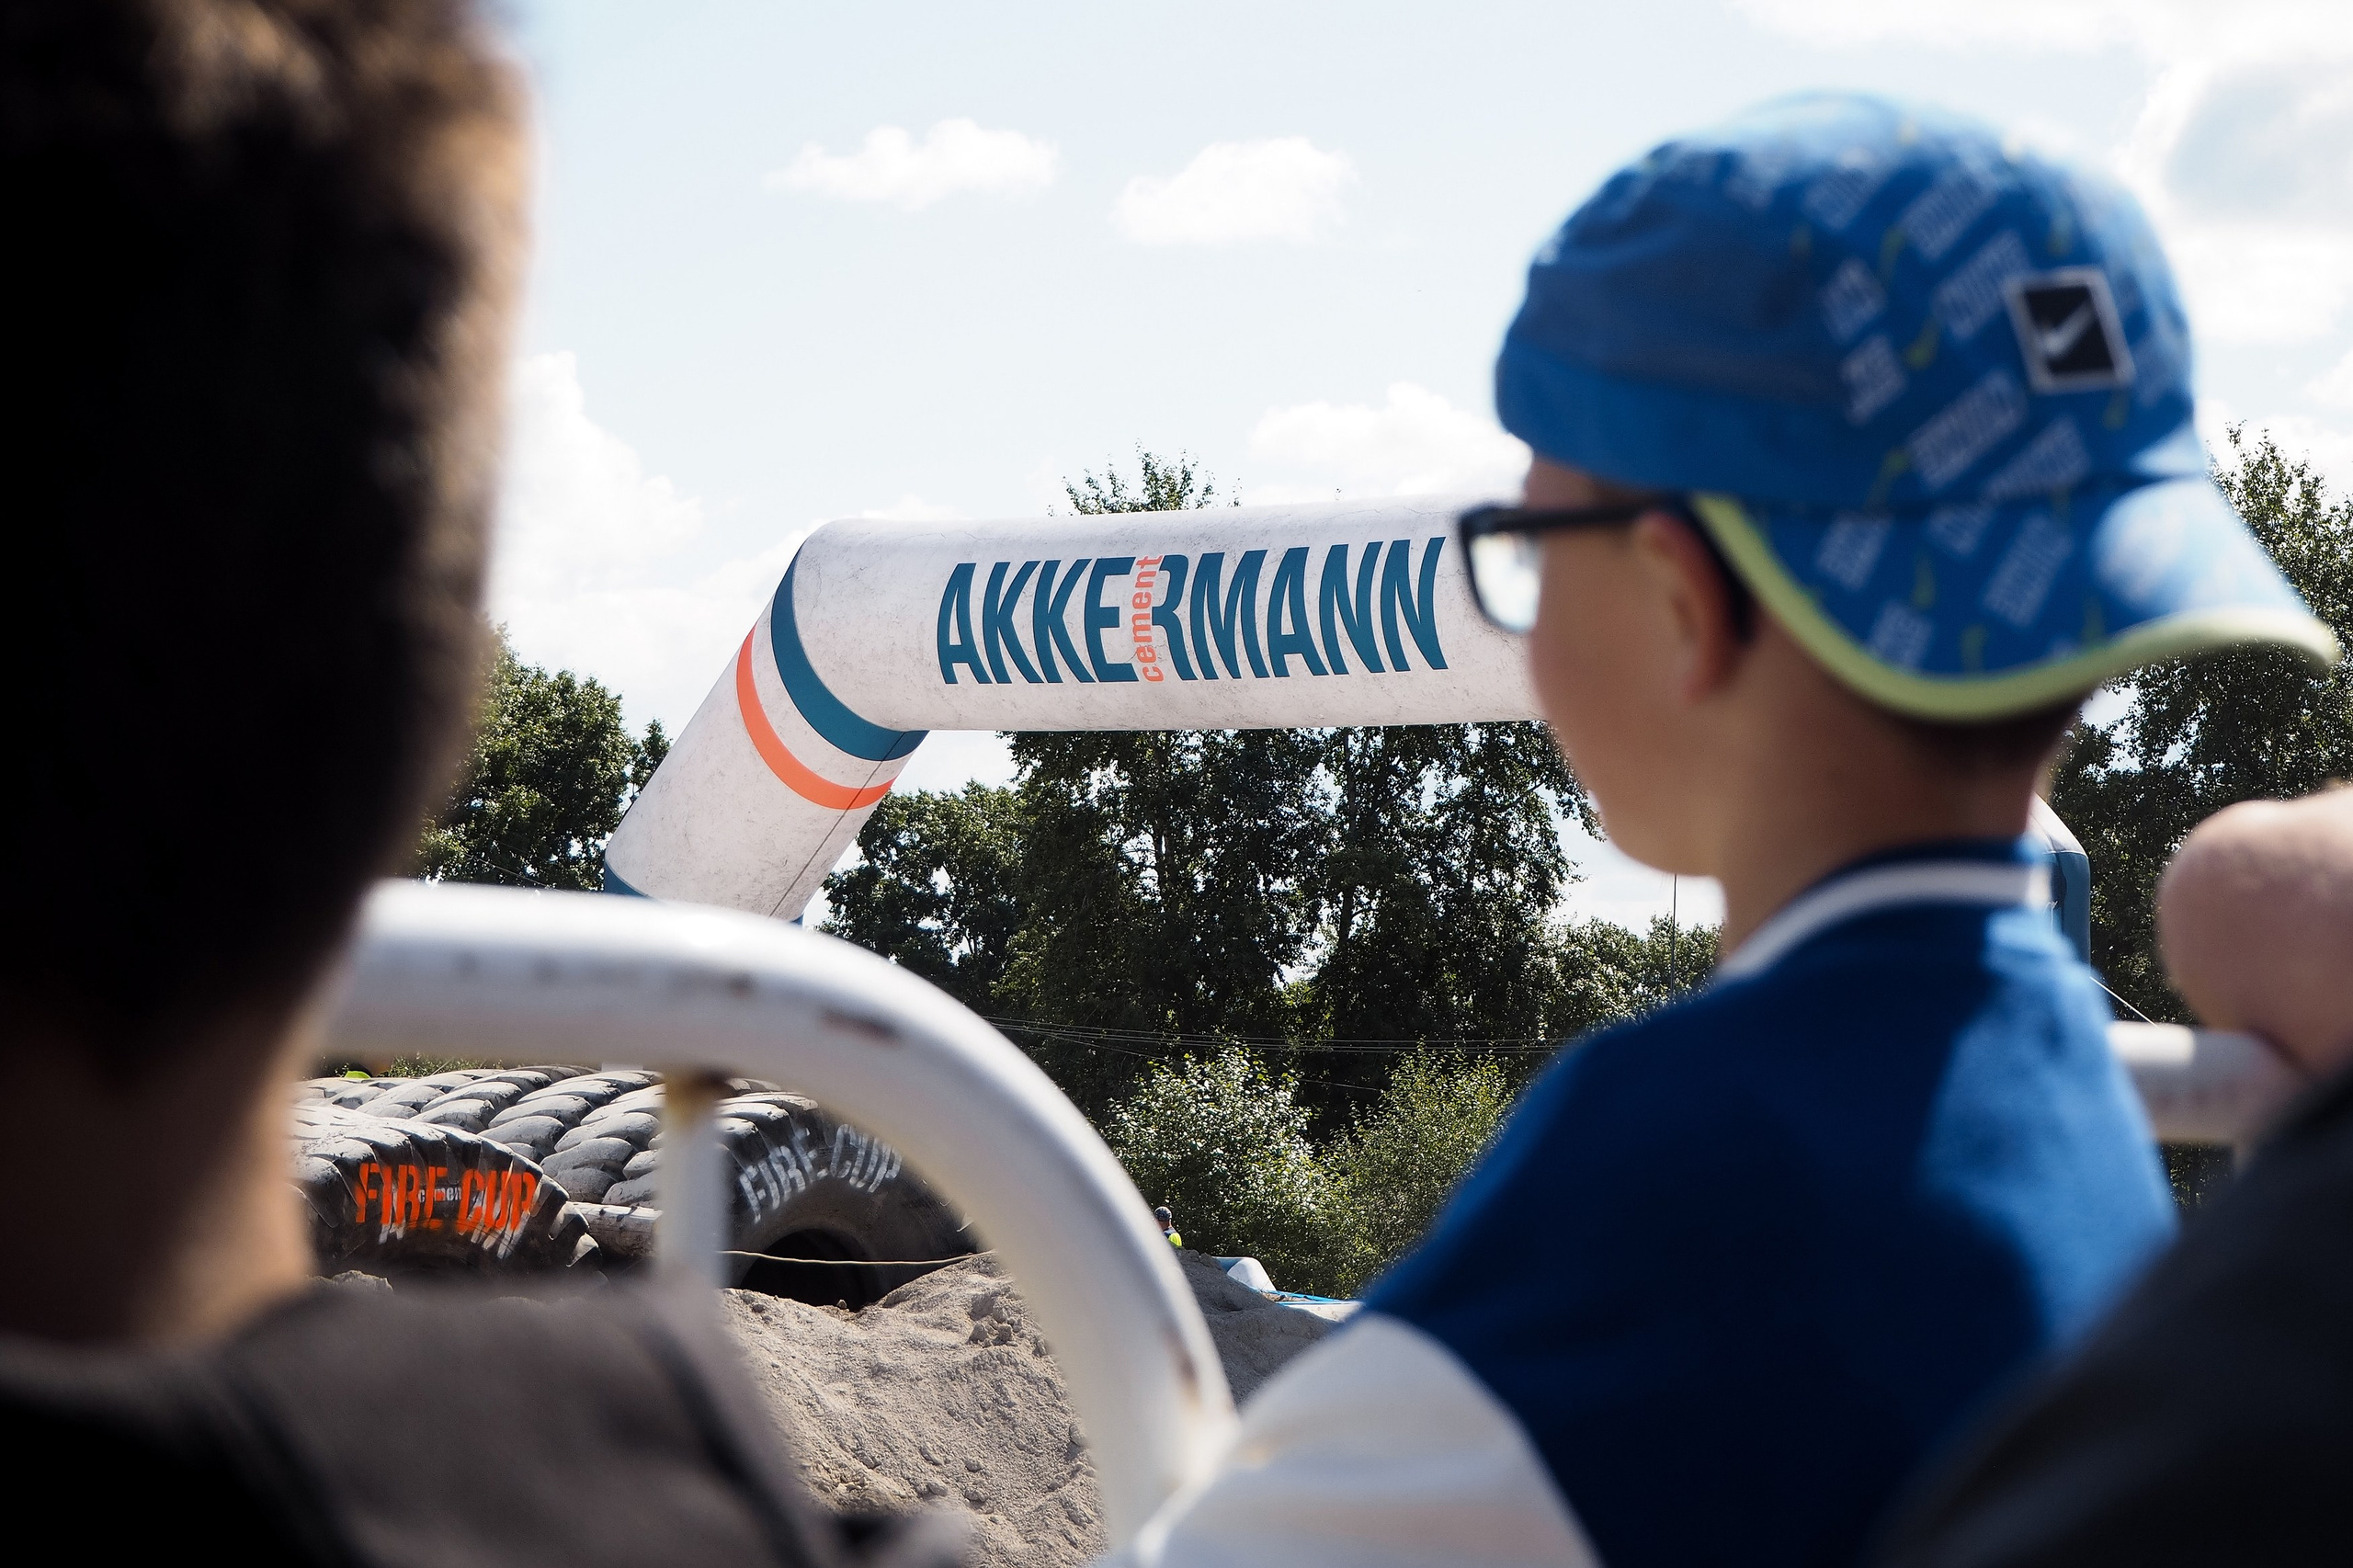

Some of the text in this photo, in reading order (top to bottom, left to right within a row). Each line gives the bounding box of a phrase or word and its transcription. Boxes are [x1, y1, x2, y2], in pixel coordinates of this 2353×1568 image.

[937, 537, 1449, 684] AKKERMANN
[1131, 554, 1165, 683] cement
[355, 1163, 539, 1234] FIRE CUP
[738, 1123, 903, 1225] FIRE CUP
